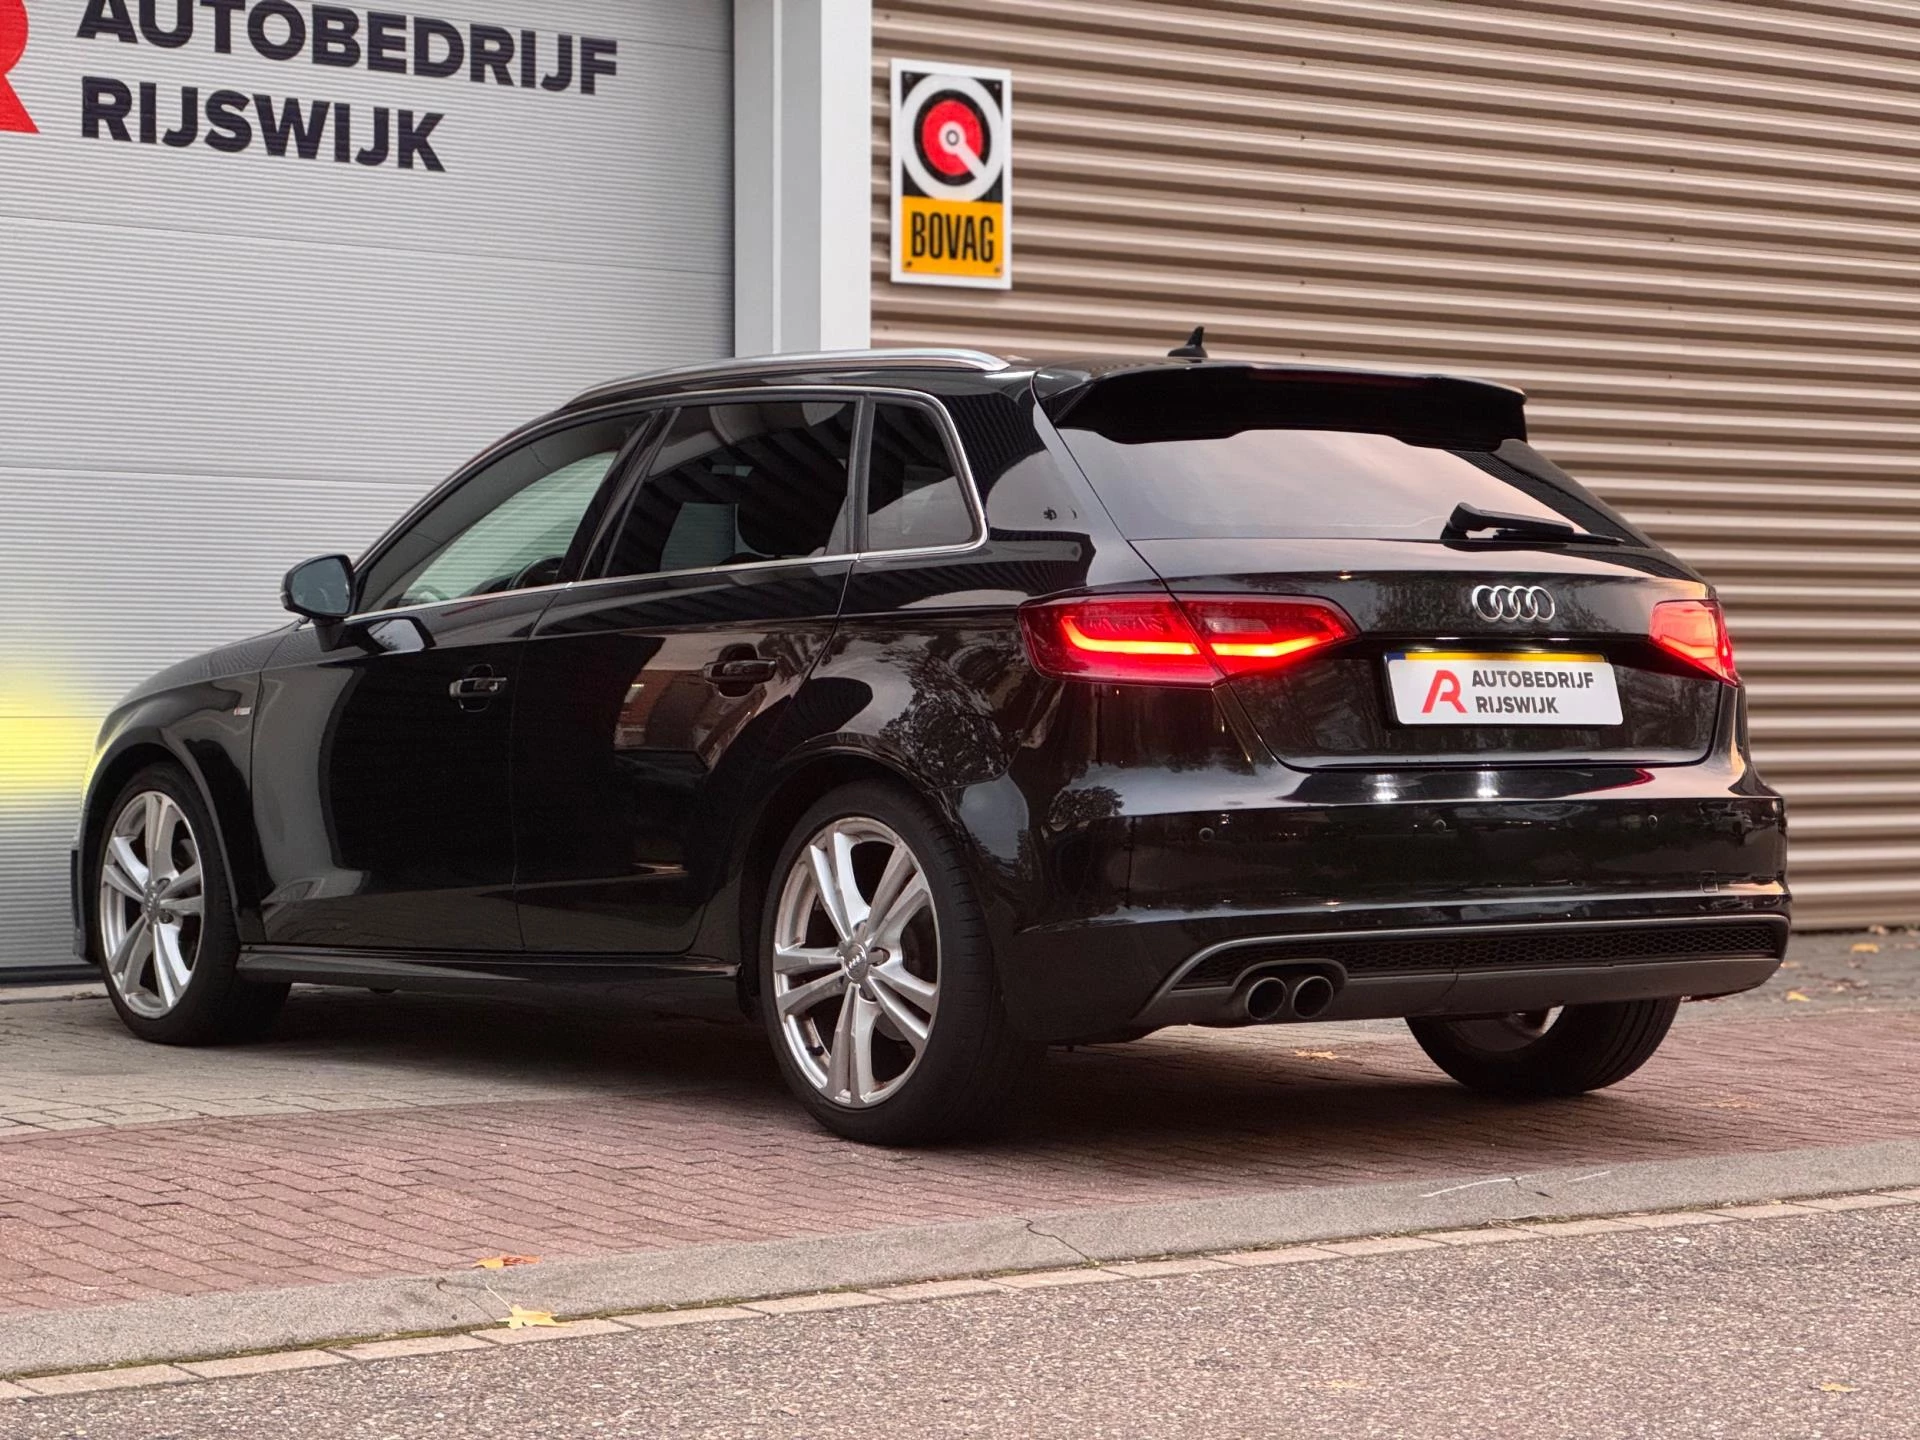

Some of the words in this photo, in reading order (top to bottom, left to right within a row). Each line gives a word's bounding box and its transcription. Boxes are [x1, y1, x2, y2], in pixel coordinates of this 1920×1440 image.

[76, 0, 617, 95] AUTOBEDRIJF
[82, 75, 446, 172] RIJSWIJK
[911, 211, 994, 263] BOVAG
[1472, 670, 1594, 689] AUTOBEDRIJF
[1475, 696, 1559, 714] RIJSWIJK
